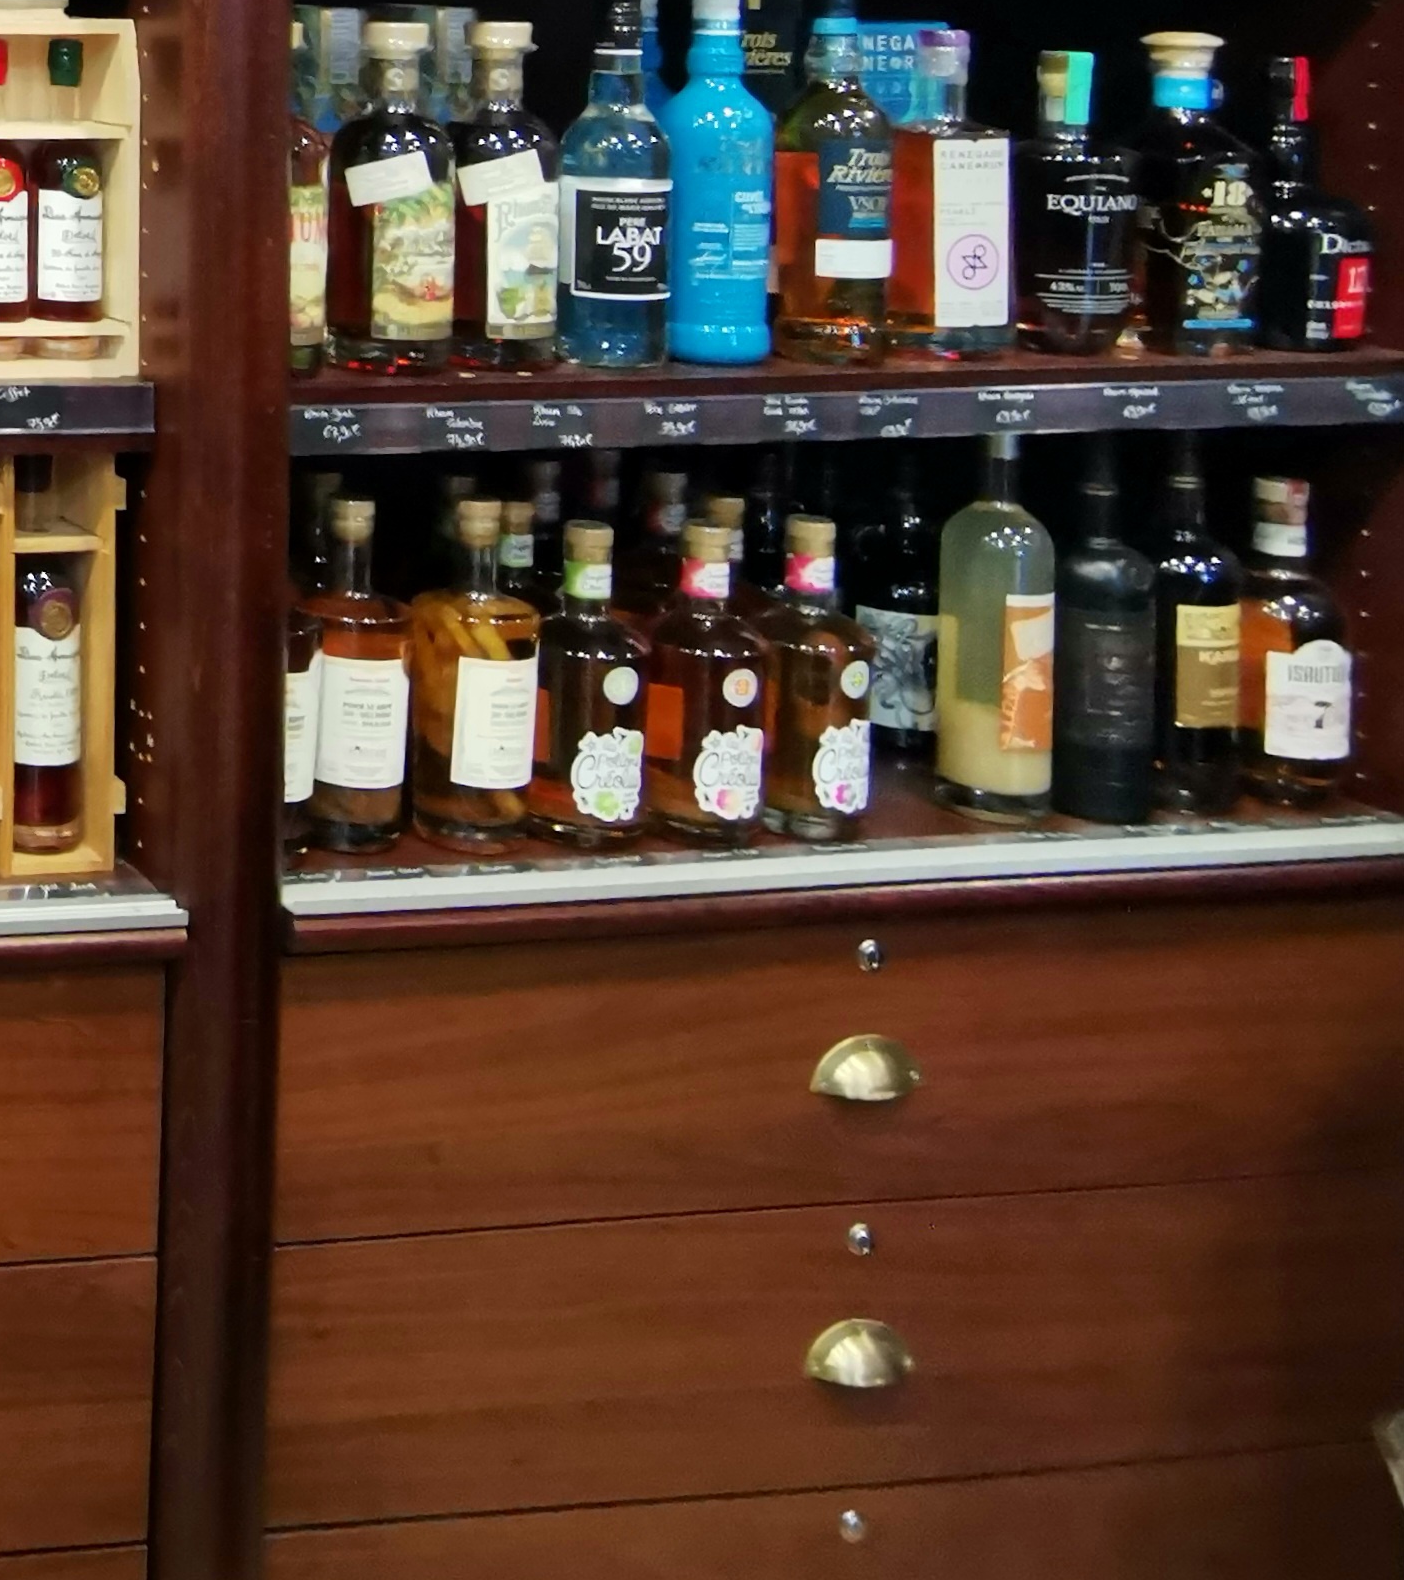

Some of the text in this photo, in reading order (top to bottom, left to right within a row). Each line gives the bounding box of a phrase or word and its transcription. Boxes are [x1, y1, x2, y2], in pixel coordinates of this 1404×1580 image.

[1046, 194, 1138, 213] EQUIANO
[596, 225, 661, 246] LABAT
[612, 243, 651, 272] 59
[1313, 701, 1332, 730] 7
